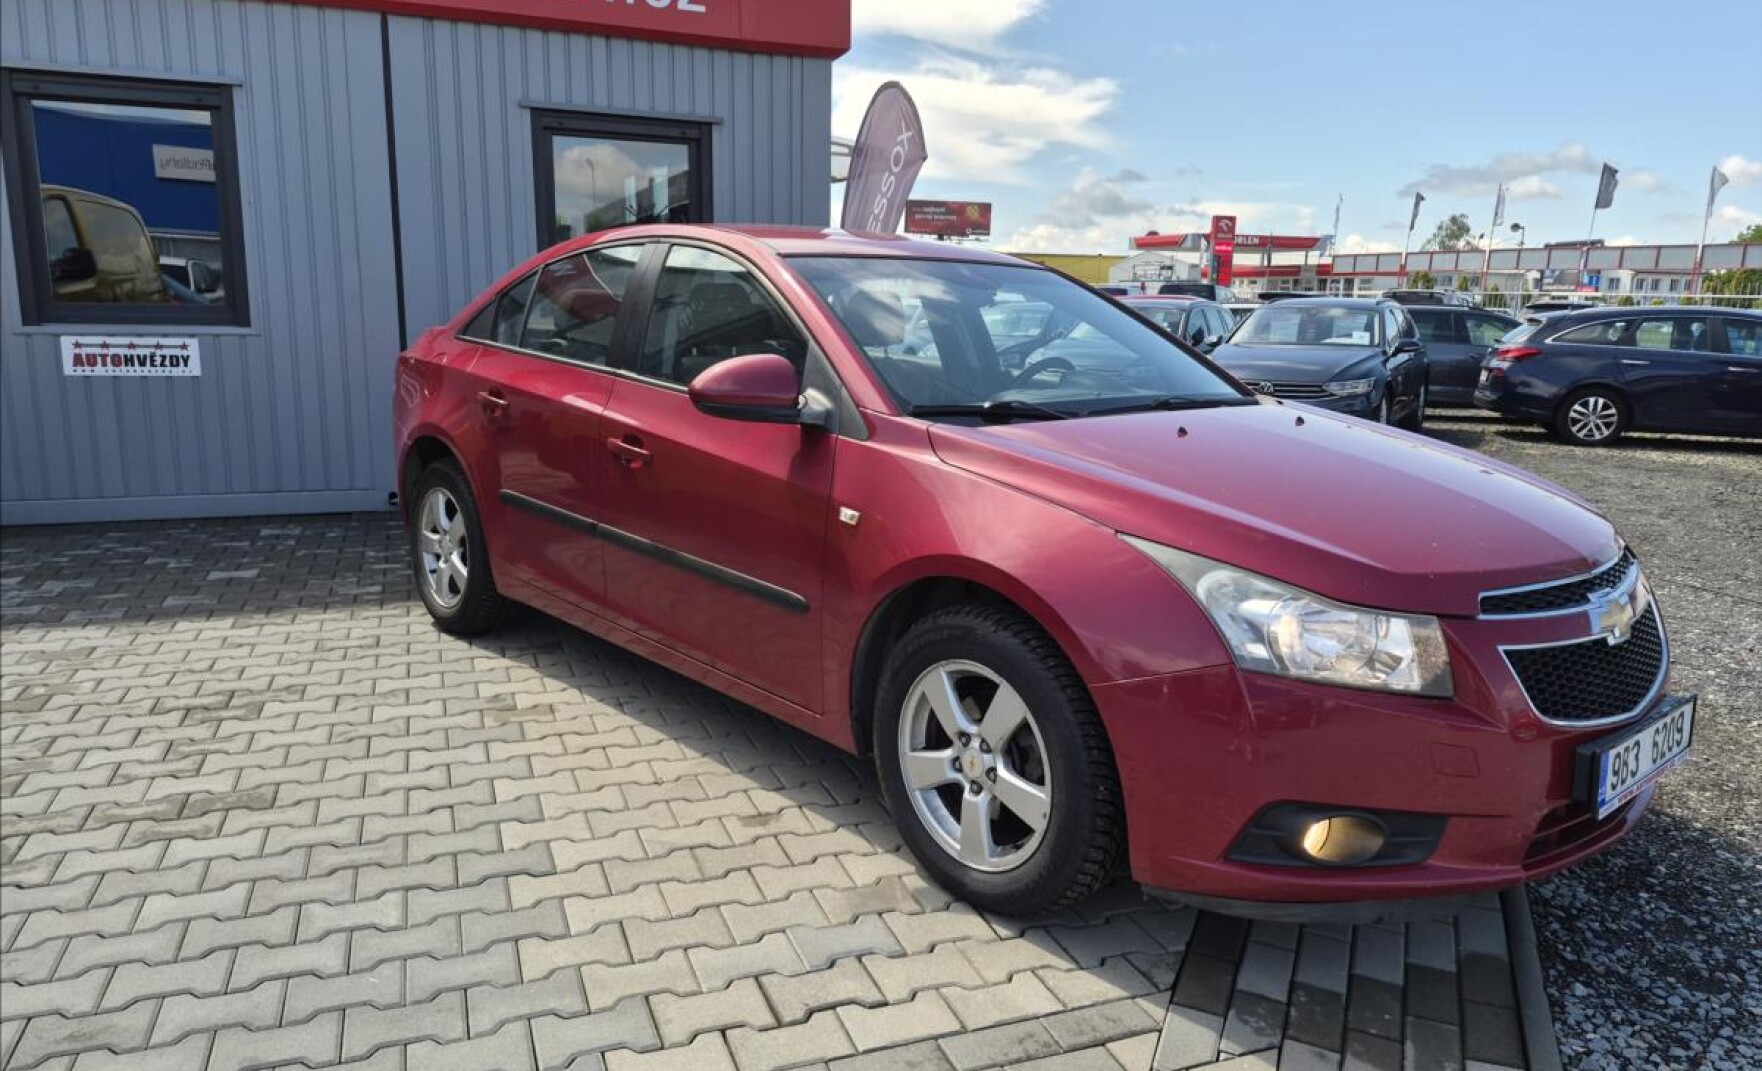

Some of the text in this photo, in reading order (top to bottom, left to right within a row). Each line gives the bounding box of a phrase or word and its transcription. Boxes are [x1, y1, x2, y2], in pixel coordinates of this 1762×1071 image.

[72, 351, 190, 368] AUTOHVĚZDY
[1611, 739, 1640, 791] 9B3
[1652, 711, 1684, 765] 6209
